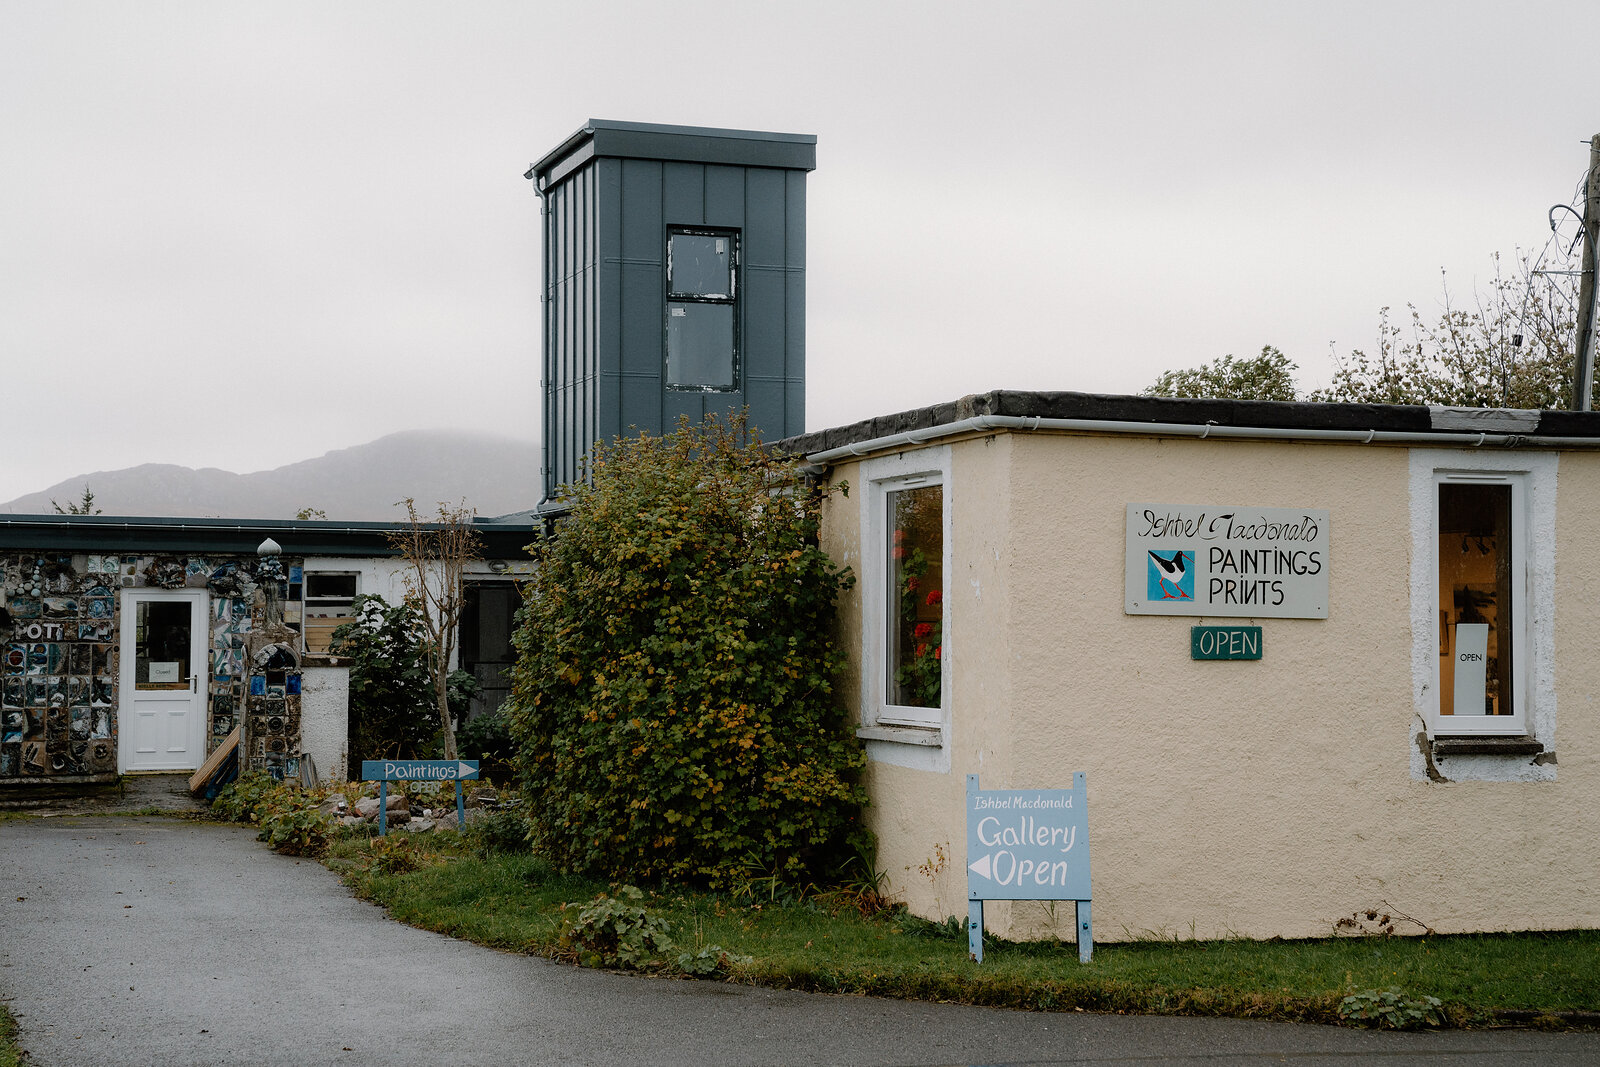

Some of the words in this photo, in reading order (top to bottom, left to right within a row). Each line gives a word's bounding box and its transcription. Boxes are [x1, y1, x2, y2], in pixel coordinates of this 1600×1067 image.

[1138, 509, 1206, 538] Ishbel
[1209, 546, 1321, 575] PAINTINGS
[1200, 630, 1257, 655] OPEN
[1459, 653, 1482, 662] OPEN
[385, 763, 457, 780] Paintings
[410, 781, 441, 793] OPEN
[974, 796, 1011, 810] Ishbel
[1013, 795, 1073, 809] Macdonald
[977, 815, 1077, 853] Gallery
[992, 850, 1068, 886] Open
